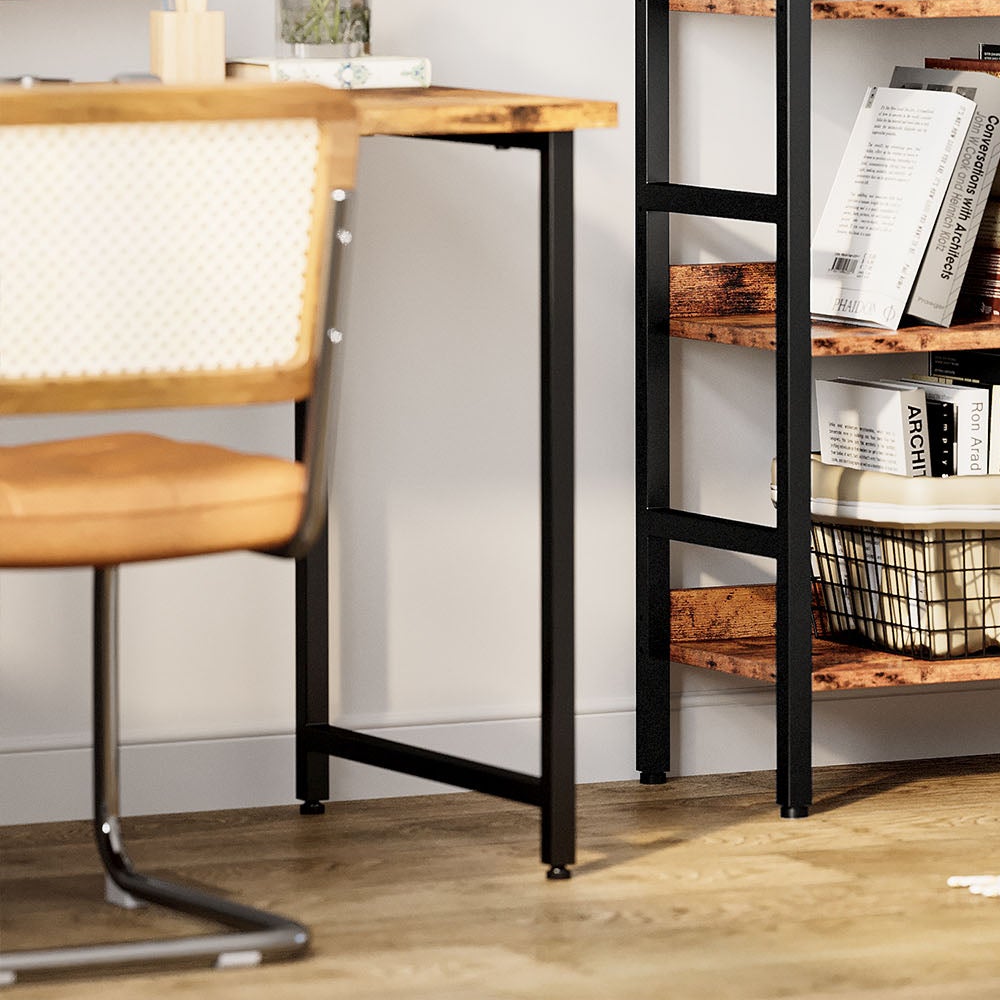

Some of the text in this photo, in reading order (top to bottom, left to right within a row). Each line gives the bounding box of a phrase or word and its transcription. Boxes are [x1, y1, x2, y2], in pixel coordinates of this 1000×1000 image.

[970, 110, 986, 135] John
[966, 115, 1000, 195] Conversations
[954, 173, 967, 191] and
[942, 192, 962, 230] Heinrich
[958, 199, 974, 221] with
[935, 231, 951, 252] Klotz
[940, 223, 967, 280] Architects
[970, 402, 984, 471] Ron Arad
